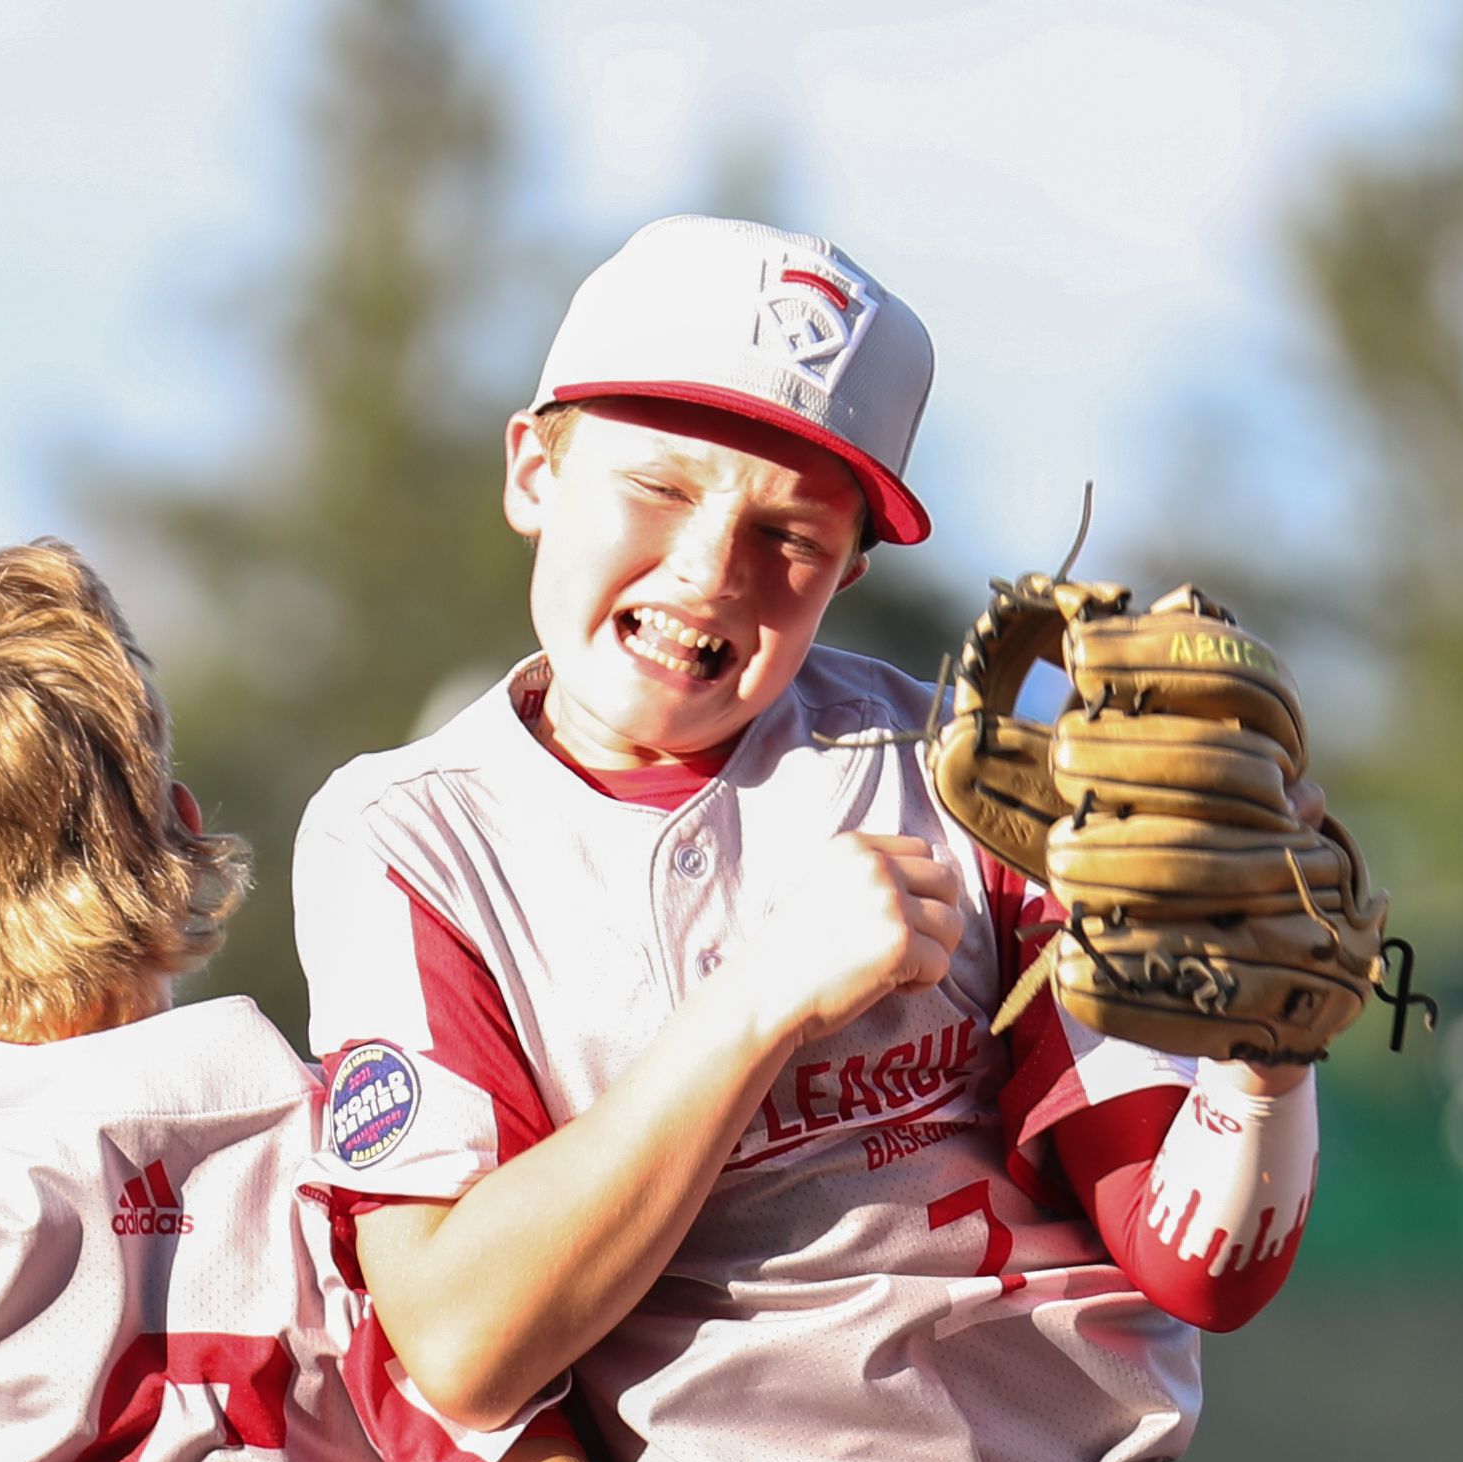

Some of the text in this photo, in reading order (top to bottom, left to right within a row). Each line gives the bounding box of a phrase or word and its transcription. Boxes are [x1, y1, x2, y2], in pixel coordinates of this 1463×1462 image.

[334, 1070, 405, 1125] WORLD
[760, 1015, 979, 1142] LEAGUE
[336, 1085, 410, 1143] SERIES
[111, 1206, 194, 1236] adidas
[927, 1178, 1027, 1295] 7
